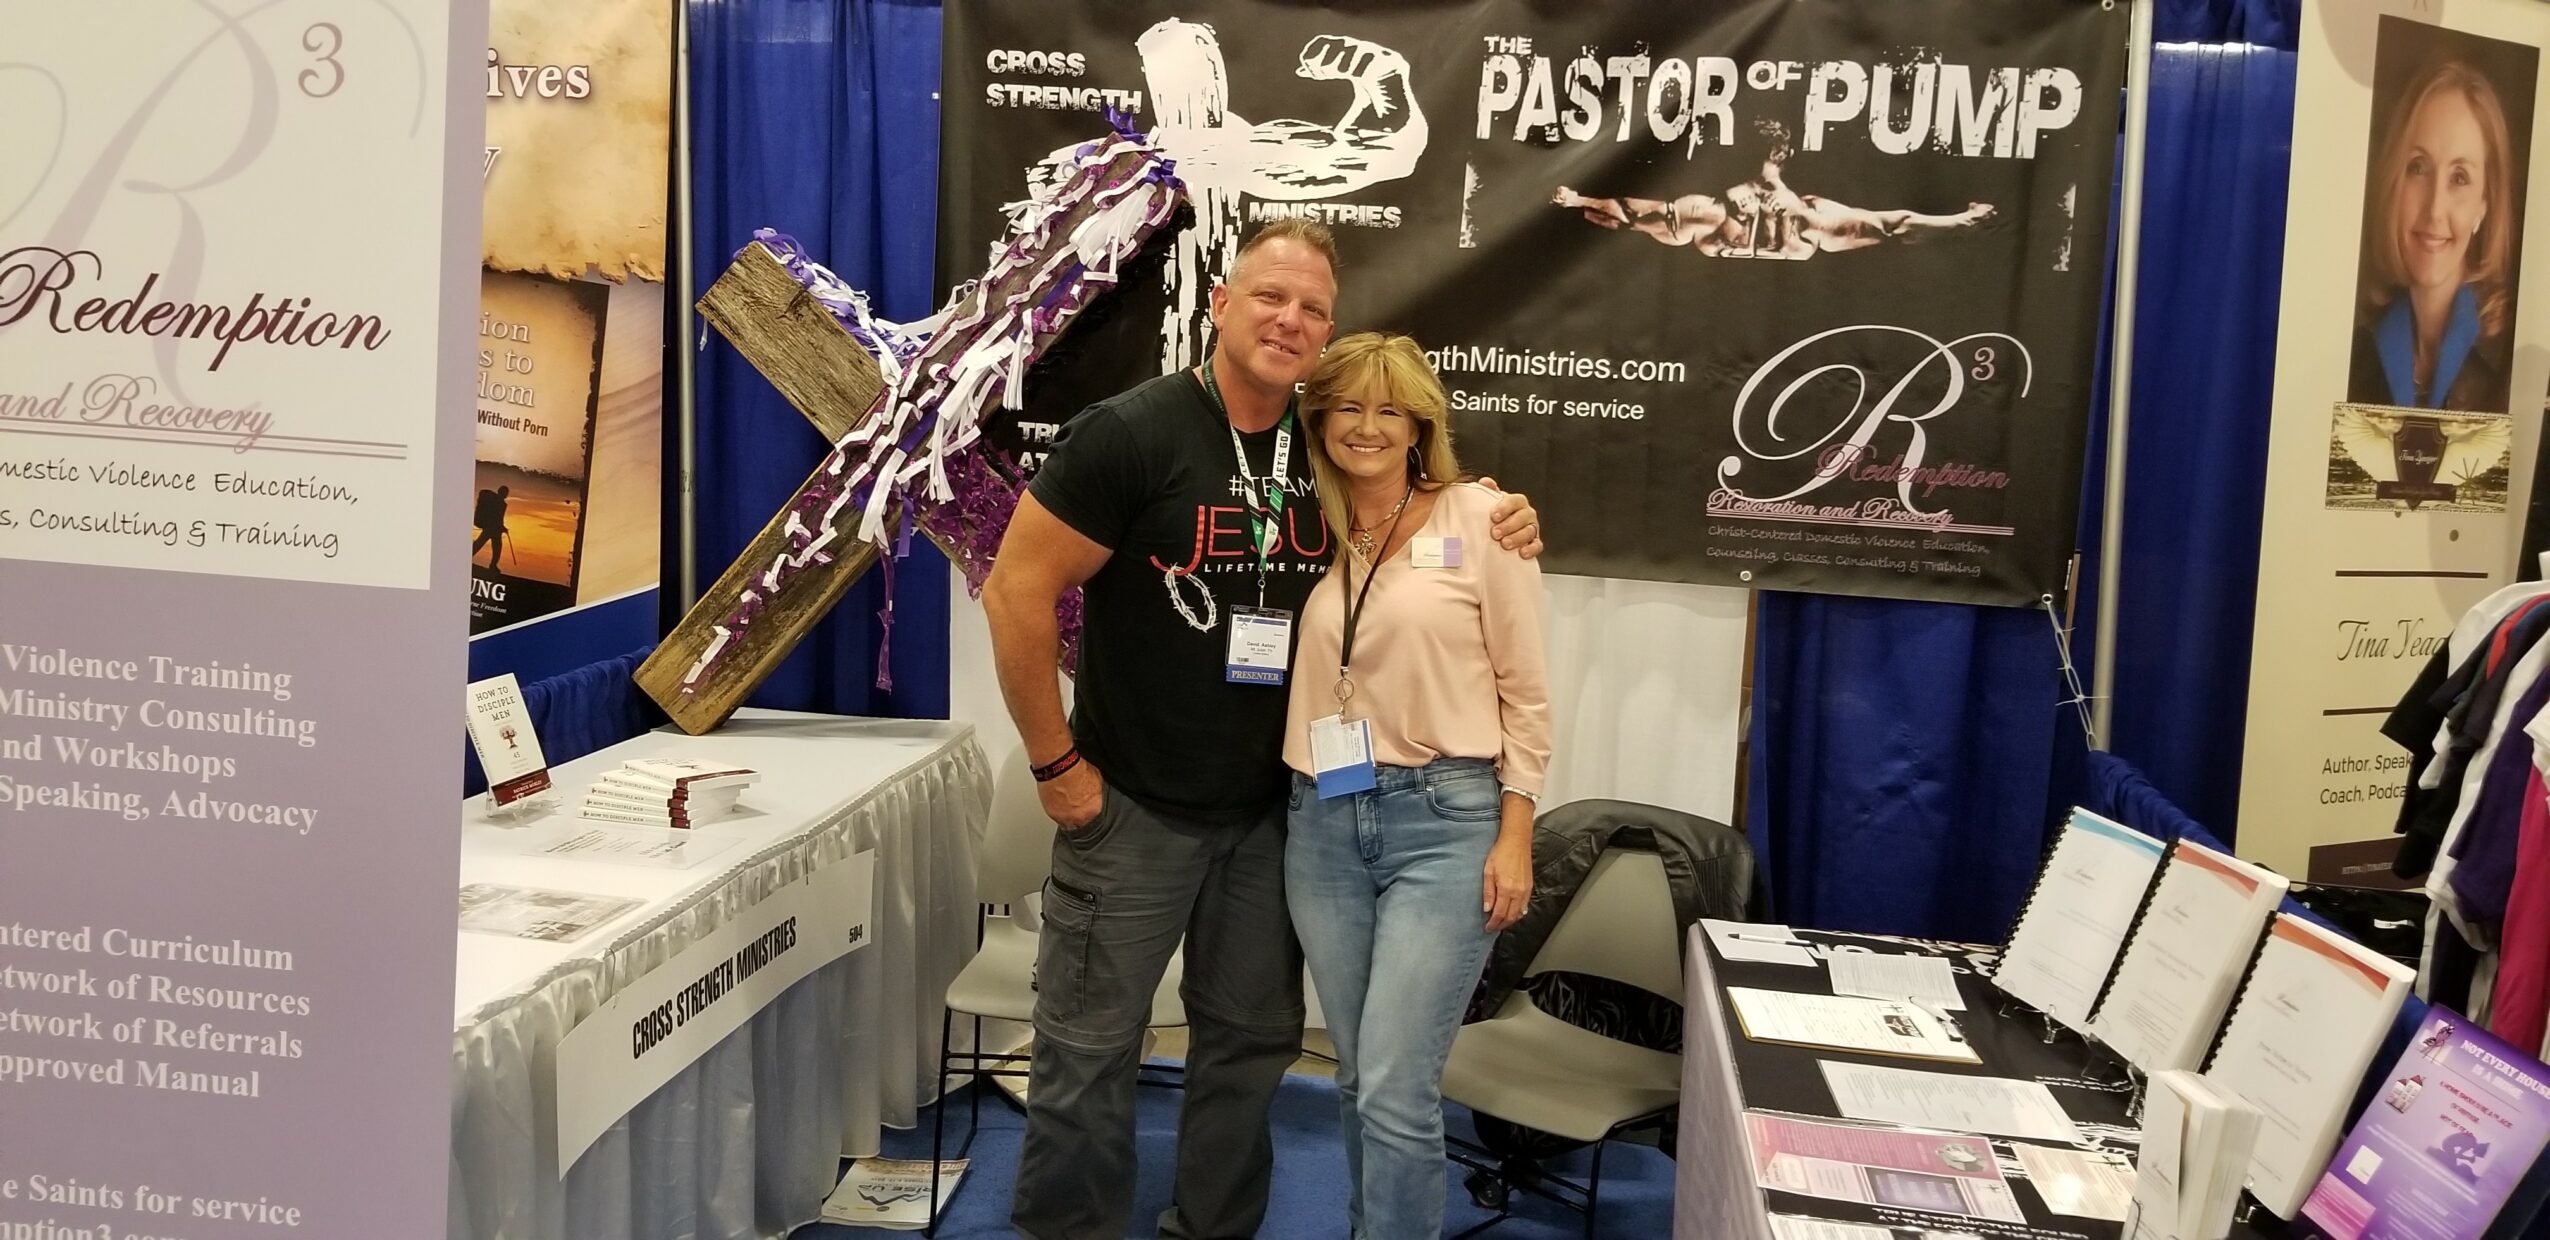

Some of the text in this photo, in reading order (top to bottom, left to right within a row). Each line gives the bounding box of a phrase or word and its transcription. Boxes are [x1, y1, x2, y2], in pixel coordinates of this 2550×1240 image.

[298, 21, 345, 98] 3
[986, 49, 1086, 77] CROSS
[1484, 36, 1532, 55] THE
[486, 48, 591, 98] ives
[986, 83, 1143, 114] STRENGTH
[1476, 52, 2083, 160] PASTOR OF PUMP
[1249, 201, 1402, 229] MINISTRIES
[0, 246, 391, 372] Redemption
[480, 311, 529, 343] ion
[505, 349, 534, 374] to
[1971, 347, 1996, 382] 3
[0, 373, 275, 455] and Recovery
[477, 408, 549, 437] Without Porn
[1451, 389, 1645, 420] Saints for service
[1275, 435, 1289, 478] LET'S GO
[1814, 442, 2011, 498] Redemption
[89, 461, 196, 491] Violence
[214, 471, 359, 505] Education,
[1706, 488, 1954, 533] Restoration and Recovery
[30, 507, 179, 546] Consulting
[187, 520, 208, 547] &
[216, 521, 340, 558] Training
[1707, 525, 1803, 542] Christ-Centered
[1805, 532, 1862, 547] Domestic
[1864, 534, 1917, 549] Violence
[1204, 562, 1286, 574] LIFETME
[1835, 553, 1906, 573] Consulting
[1922, 560, 1982, 577] Training
[2337, 619, 2389, 661] Tina
[2, 643, 292, 701] Violence Training
[1231, 669, 1279, 681] PRESENTER
[475, 686, 509, 702] HOW TO
[477, 696, 516, 713] DISCIPLE
[491, 709, 511, 721] MEN
[0, 687, 317, 748] Ministry Consulting
[53, 735, 237, 784] Workshops
[0, 774, 319, 836] Speaking, Advocacy
[2320, 784, 2365, 805] Coach,
[102, 928, 294, 971] Curriculum
[0, 963, 311, 1016] twork of Resources
[632, 915, 863, 1060] CROSS STRENGTH MINISTRIES 504
[112, 1017, 147, 1044] of
[153, 1019, 304, 1059] Referrals
[2461, 1040, 2482, 1058] NOT
[2481, 1051, 2517, 1078] EVERY
[136, 1060, 261, 1099] Manual
[28, 1174, 124, 1210] Saints
[134, 1184, 182, 1214] for
[191, 1196, 301, 1227] service
